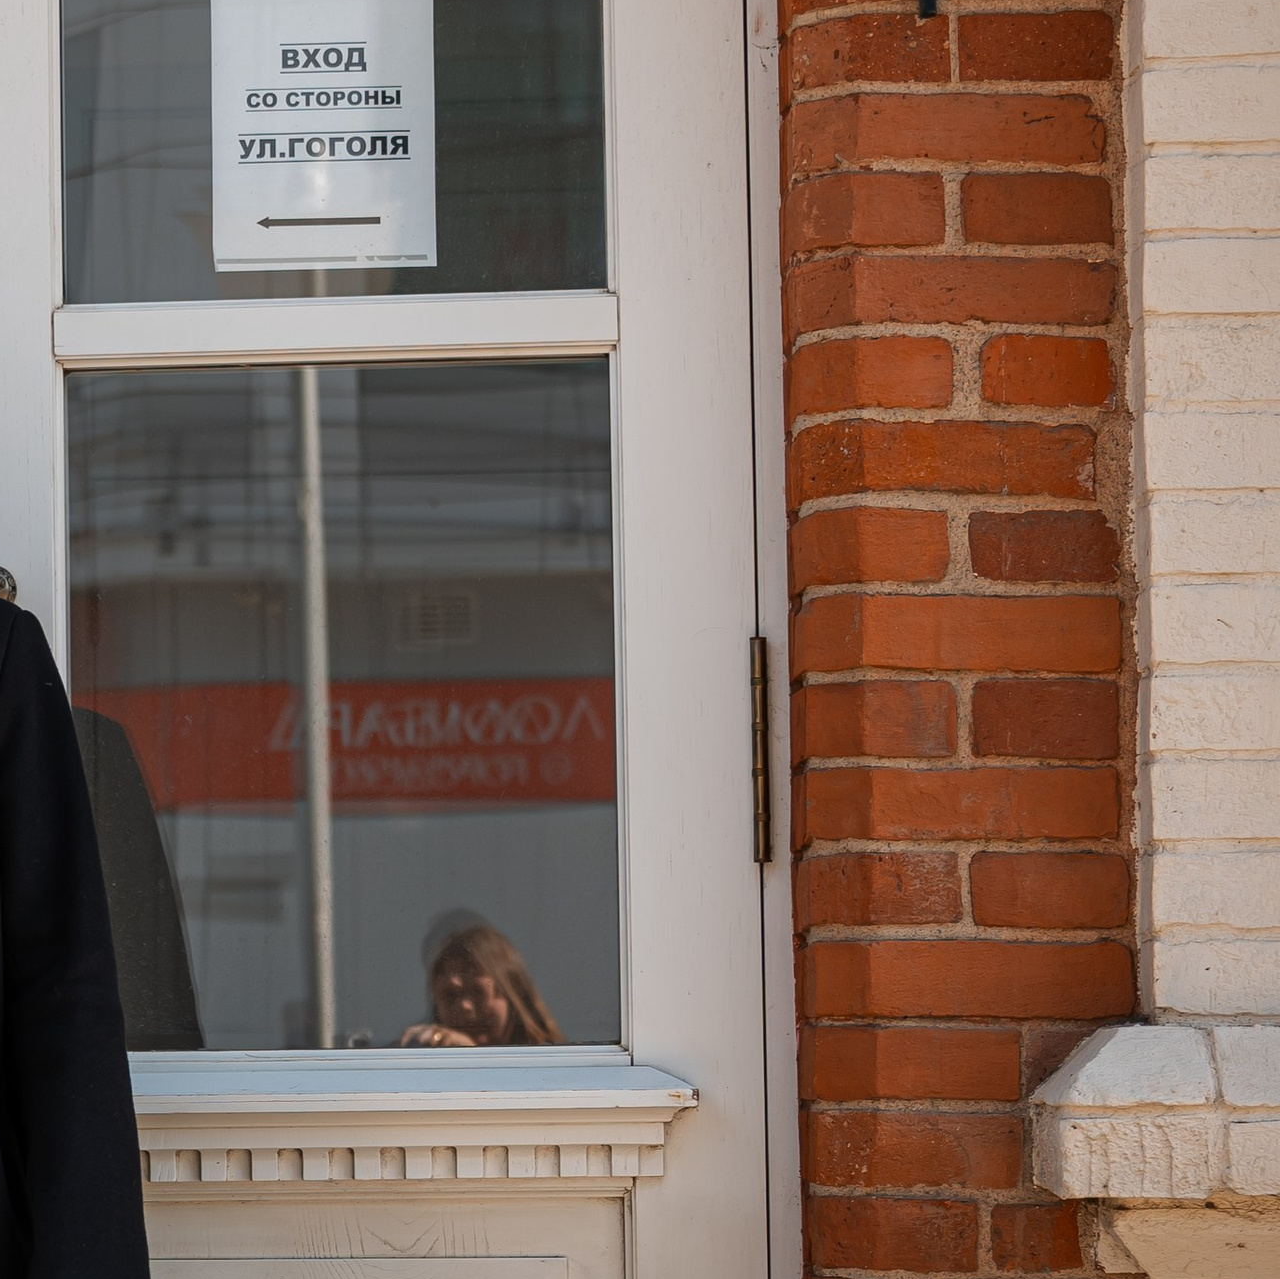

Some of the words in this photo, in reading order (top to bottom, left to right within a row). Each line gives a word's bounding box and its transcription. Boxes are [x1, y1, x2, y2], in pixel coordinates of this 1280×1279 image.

[280, 47, 367, 72] ВХОД
[246, 92, 278, 109] СО
[285, 89, 402, 108] СТОРОНЫ
[238, 134, 410, 160] УЛ.ГОГОЛЯ
